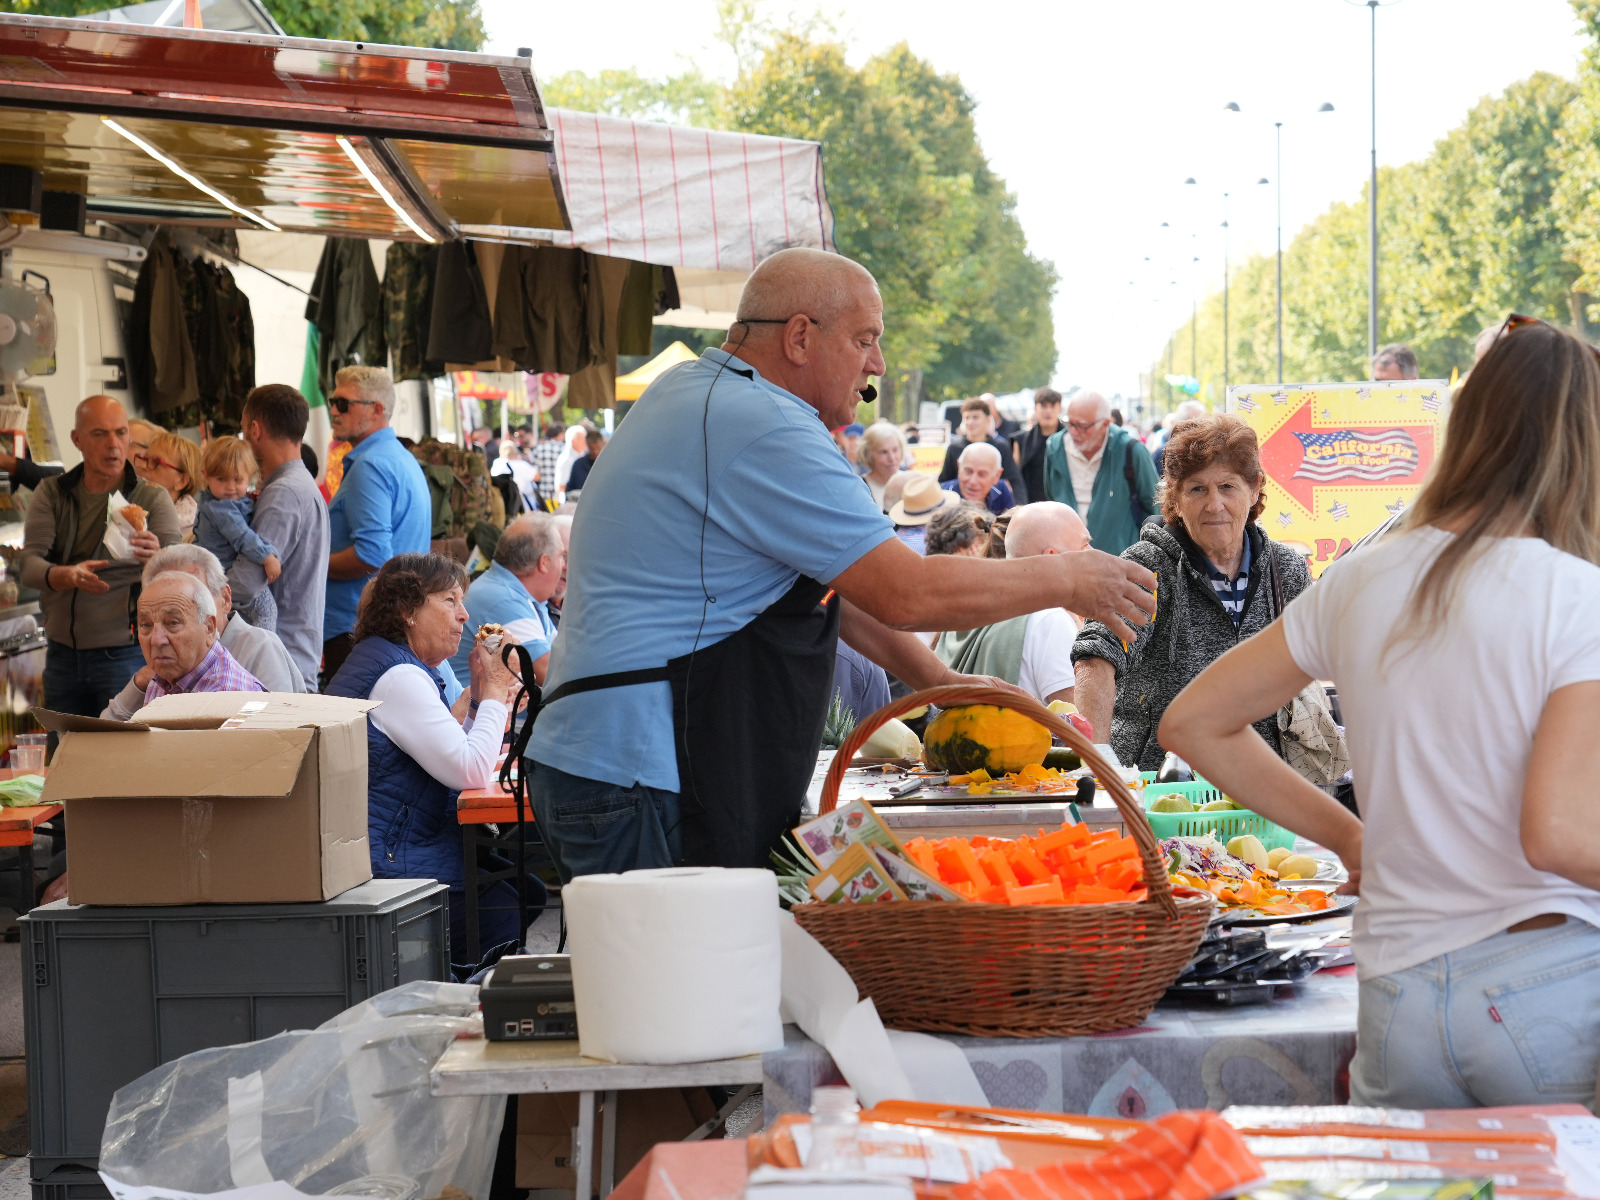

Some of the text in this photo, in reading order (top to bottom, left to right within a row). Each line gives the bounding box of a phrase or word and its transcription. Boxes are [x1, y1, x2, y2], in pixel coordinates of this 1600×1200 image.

[1305, 439, 1413, 460] California
[1337, 455, 1390, 466] Fast Food
